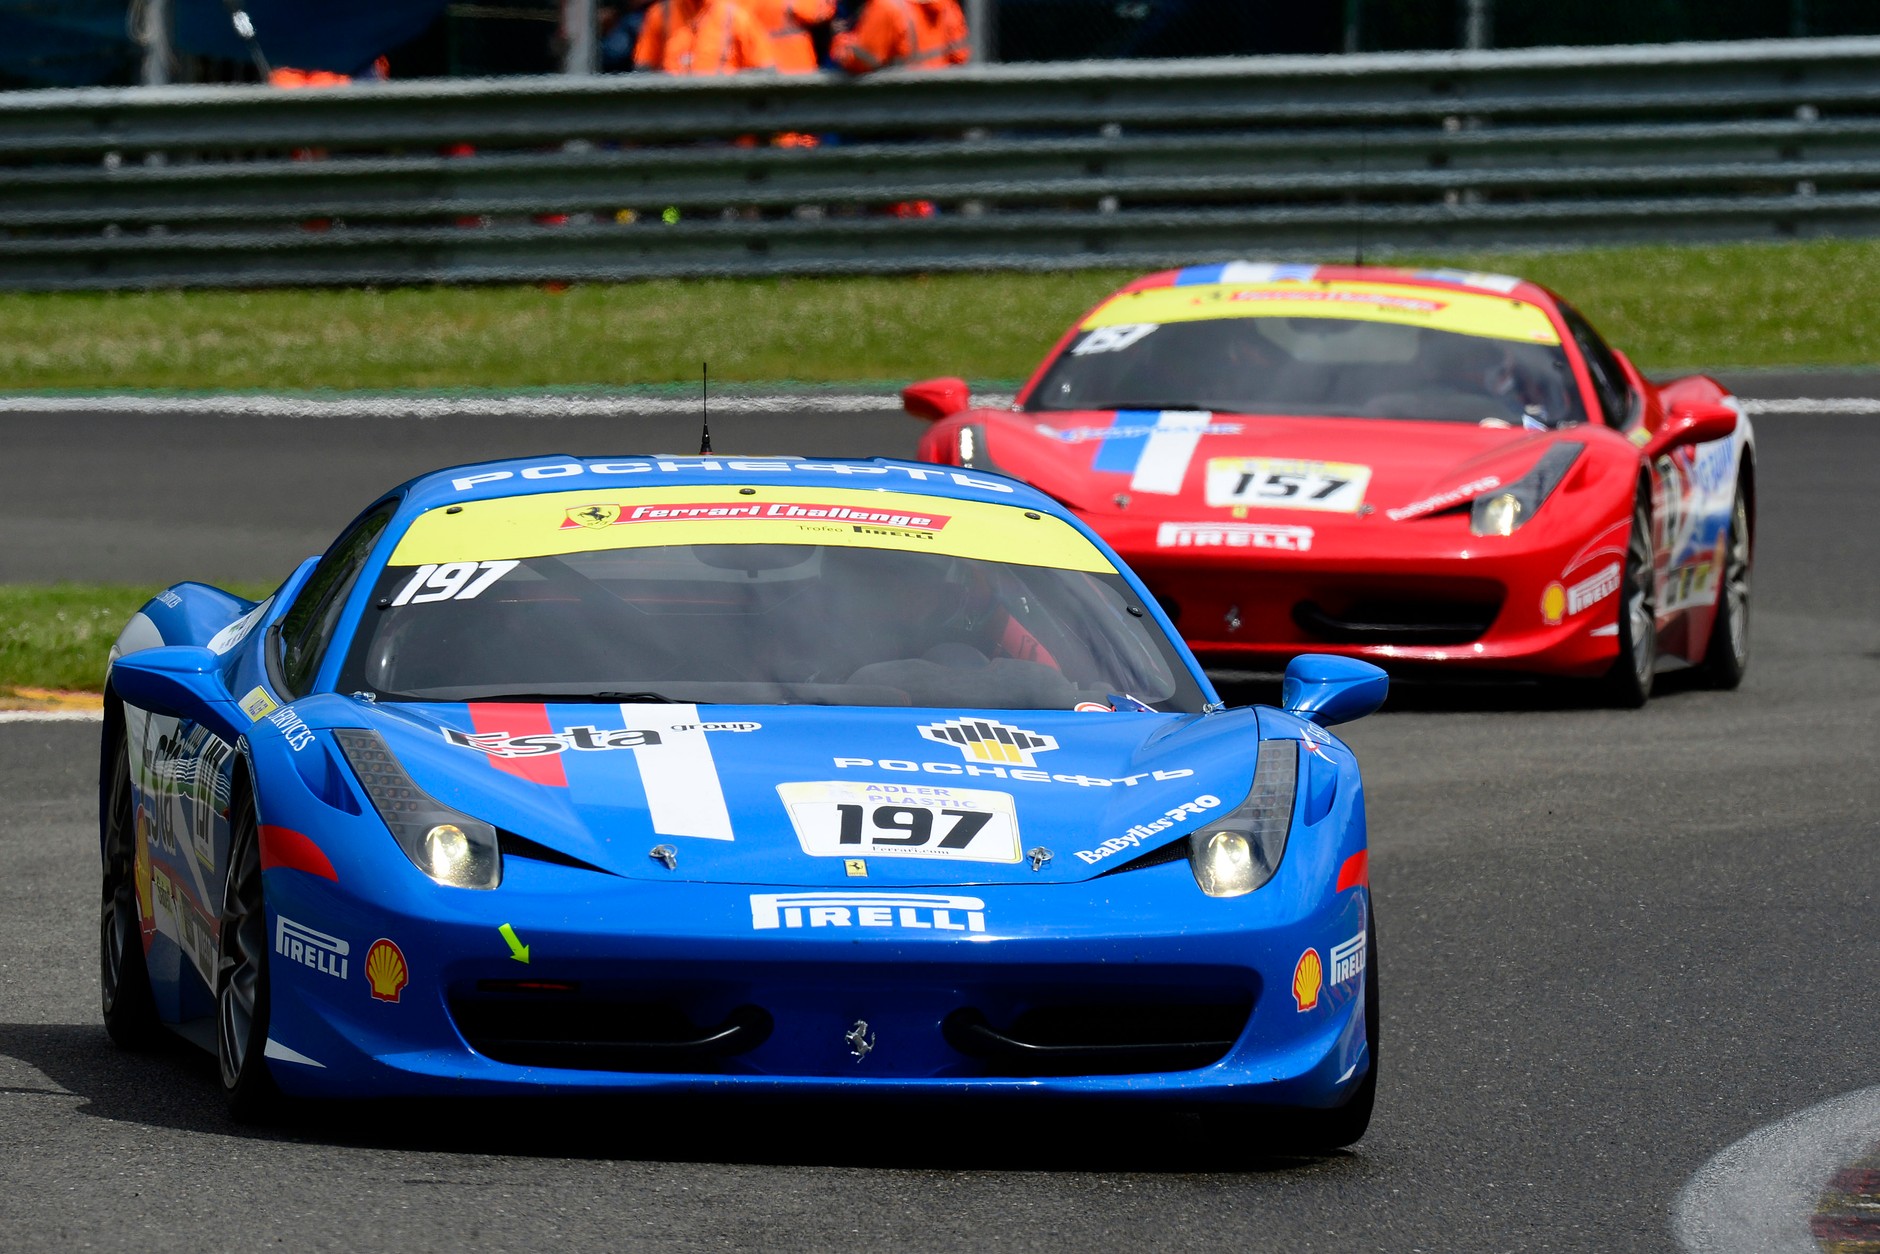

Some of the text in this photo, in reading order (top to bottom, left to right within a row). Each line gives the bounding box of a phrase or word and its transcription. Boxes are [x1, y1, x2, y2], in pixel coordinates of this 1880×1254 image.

[1231, 473, 1349, 499] 157
[631, 504, 933, 526] Ferrari Challenge
[799, 525, 934, 540] Trofeo PIRELLI
[1156, 521, 1314, 551] PIRELLI
[390, 560, 521, 607] 197
[440, 720, 763, 757] Esta group
[865, 784, 950, 797] ADLER
[868, 795, 977, 808] PLASTIC
[836, 804, 993, 849] 197
[750, 892, 985, 932] PIRELLI
[276, 914, 350, 980] PIRELLI
